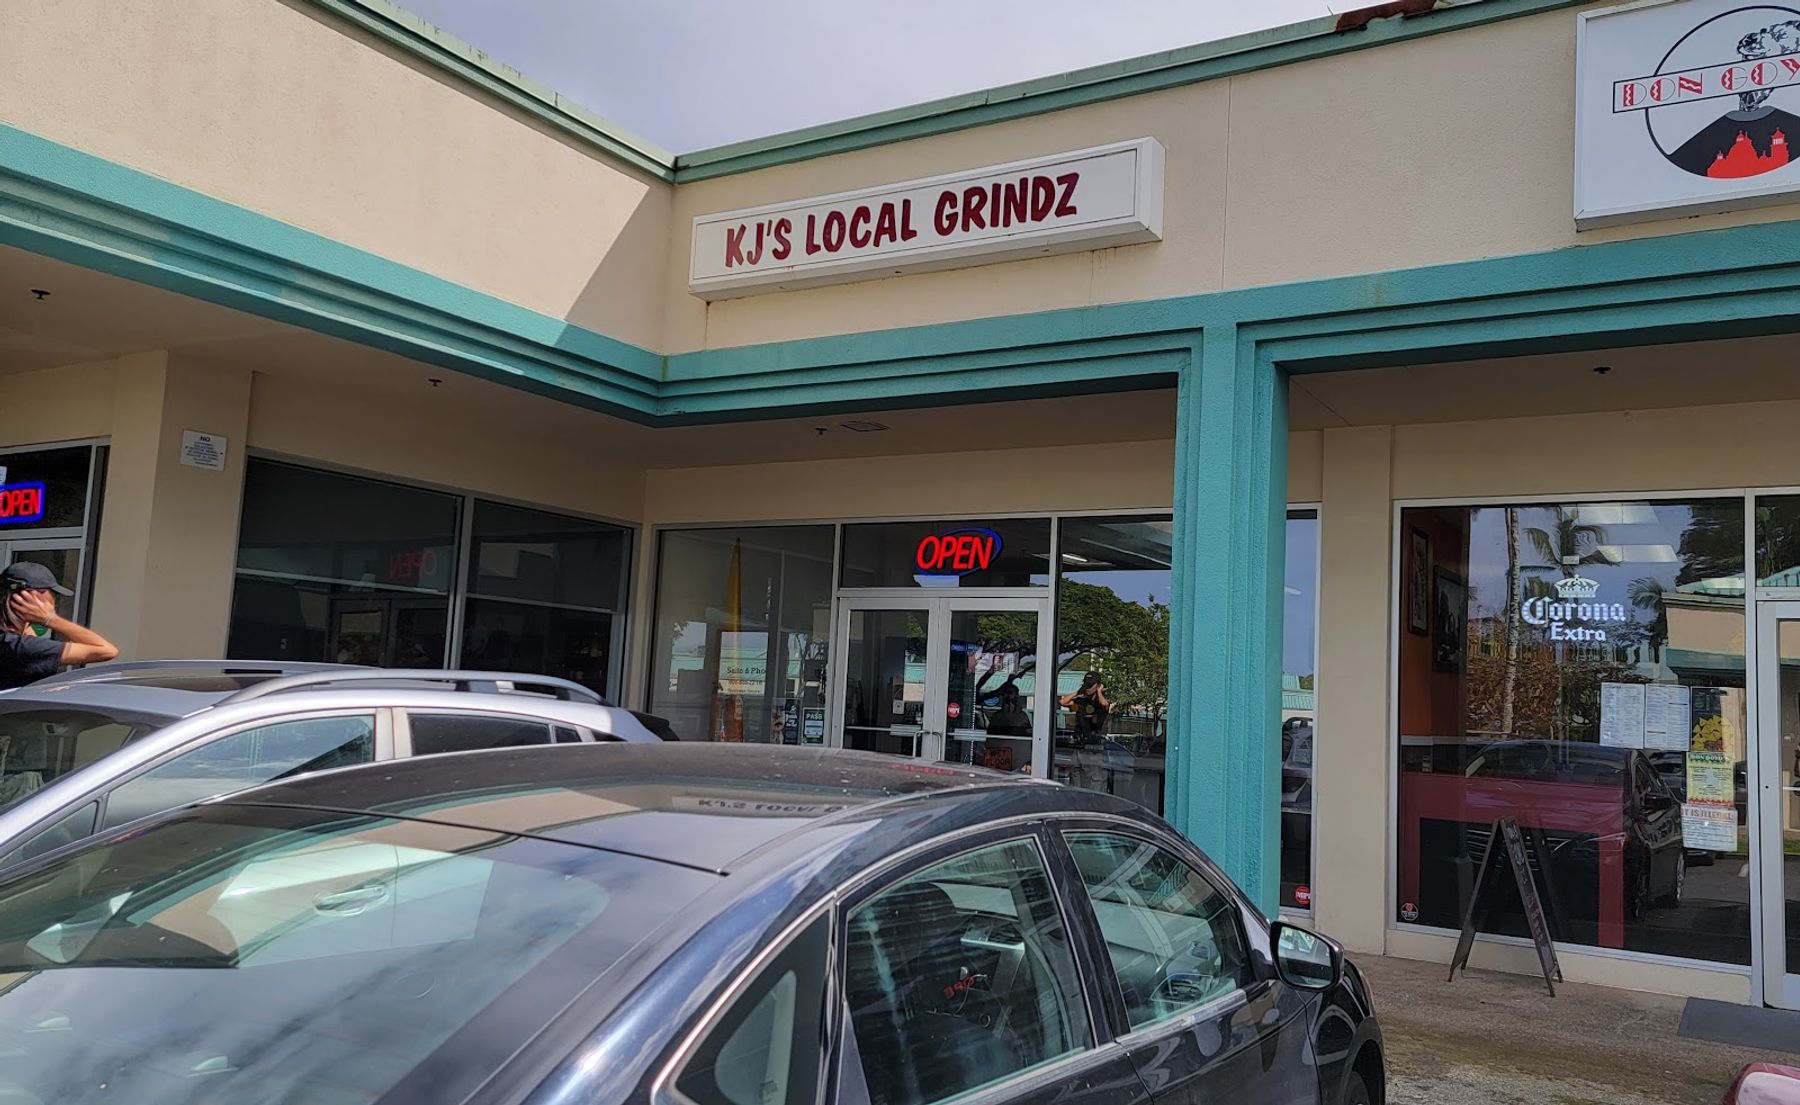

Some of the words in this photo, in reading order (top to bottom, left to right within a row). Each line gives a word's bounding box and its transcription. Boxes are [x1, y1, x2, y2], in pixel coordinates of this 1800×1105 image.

[1622, 73, 1703, 107] DON
[725, 217, 792, 268] KJ'S
[805, 199, 917, 256] LOCAL
[934, 172, 1080, 237] GRINDZ
[0, 489, 41, 517] OPEN
[917, 535, 993, 569] OPEN
[1521, 596, 1626, 627] Corona
[1551, 621, 1606, 641] Extra
